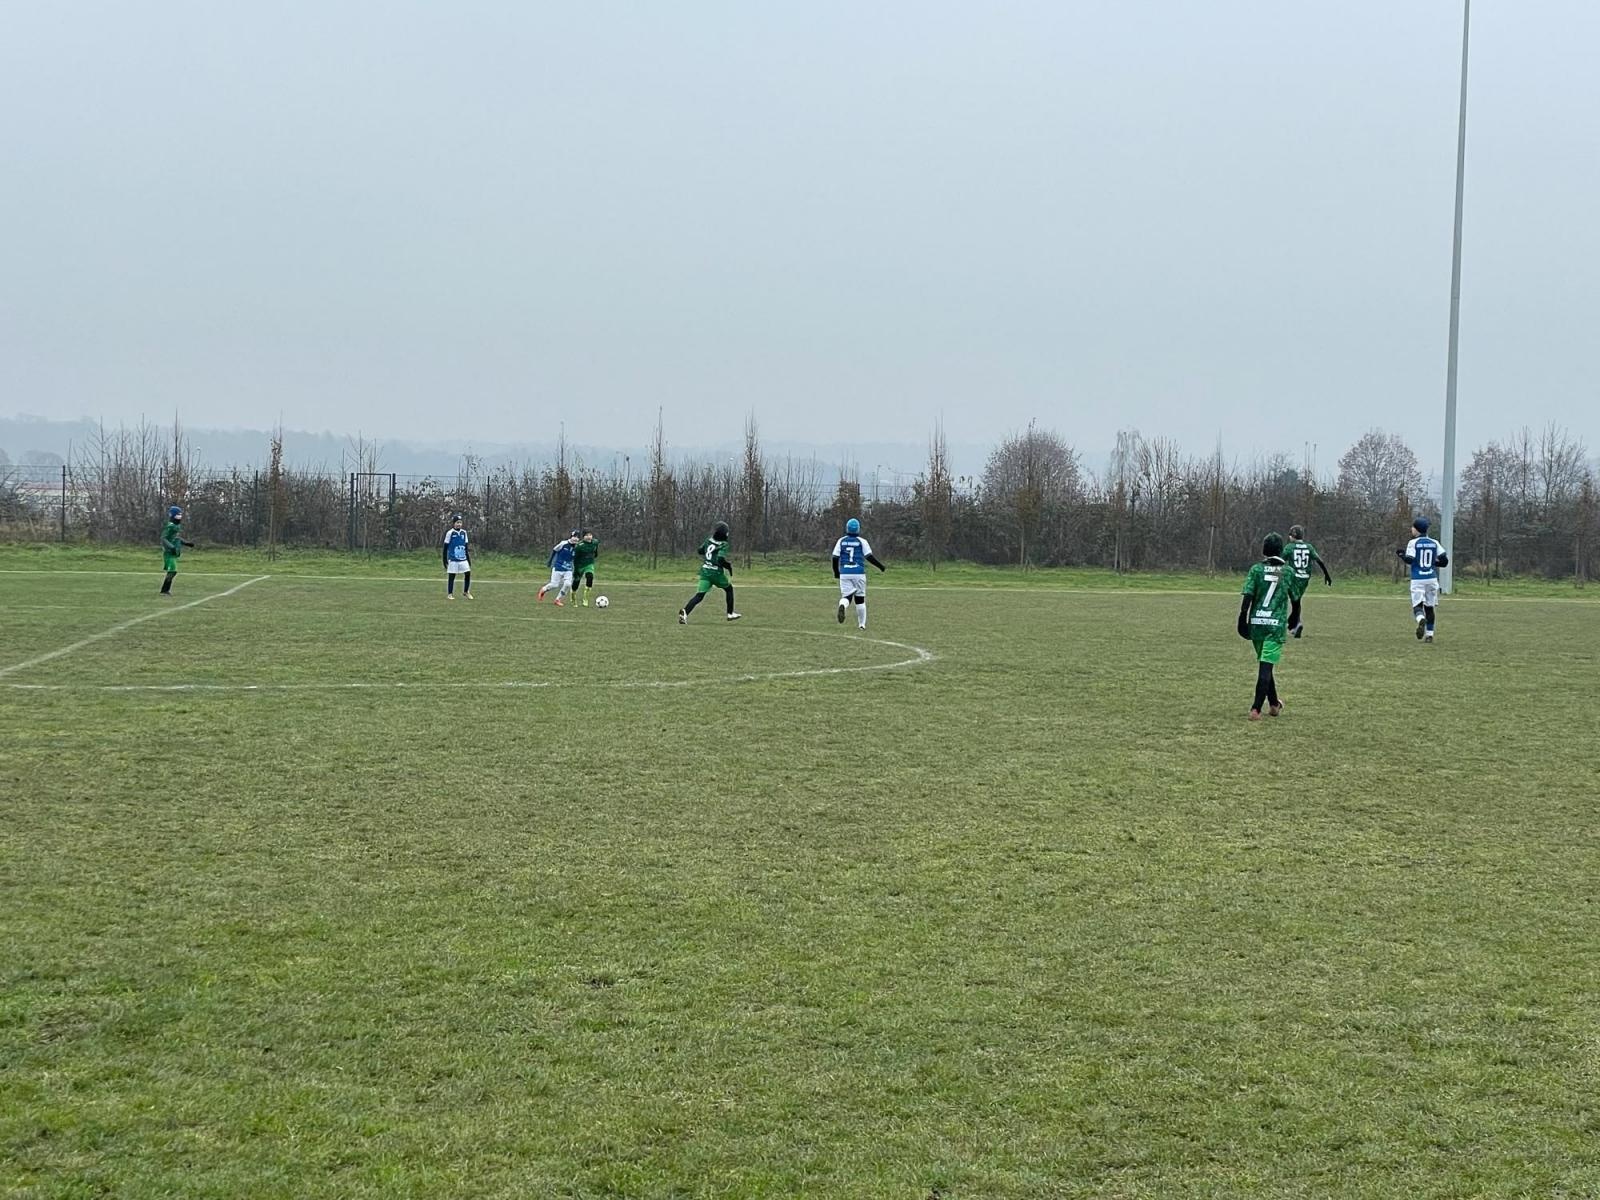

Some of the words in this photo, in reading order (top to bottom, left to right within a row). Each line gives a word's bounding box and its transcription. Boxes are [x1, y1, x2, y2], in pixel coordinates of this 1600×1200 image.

[705, 543, 716, 560] 8
[845, 546, 855, 563] 7
[1293, 549, 1310, 568] 55
[1420, 549, 1433, 568] 10
[1262, 574, 1279, 608] 7
